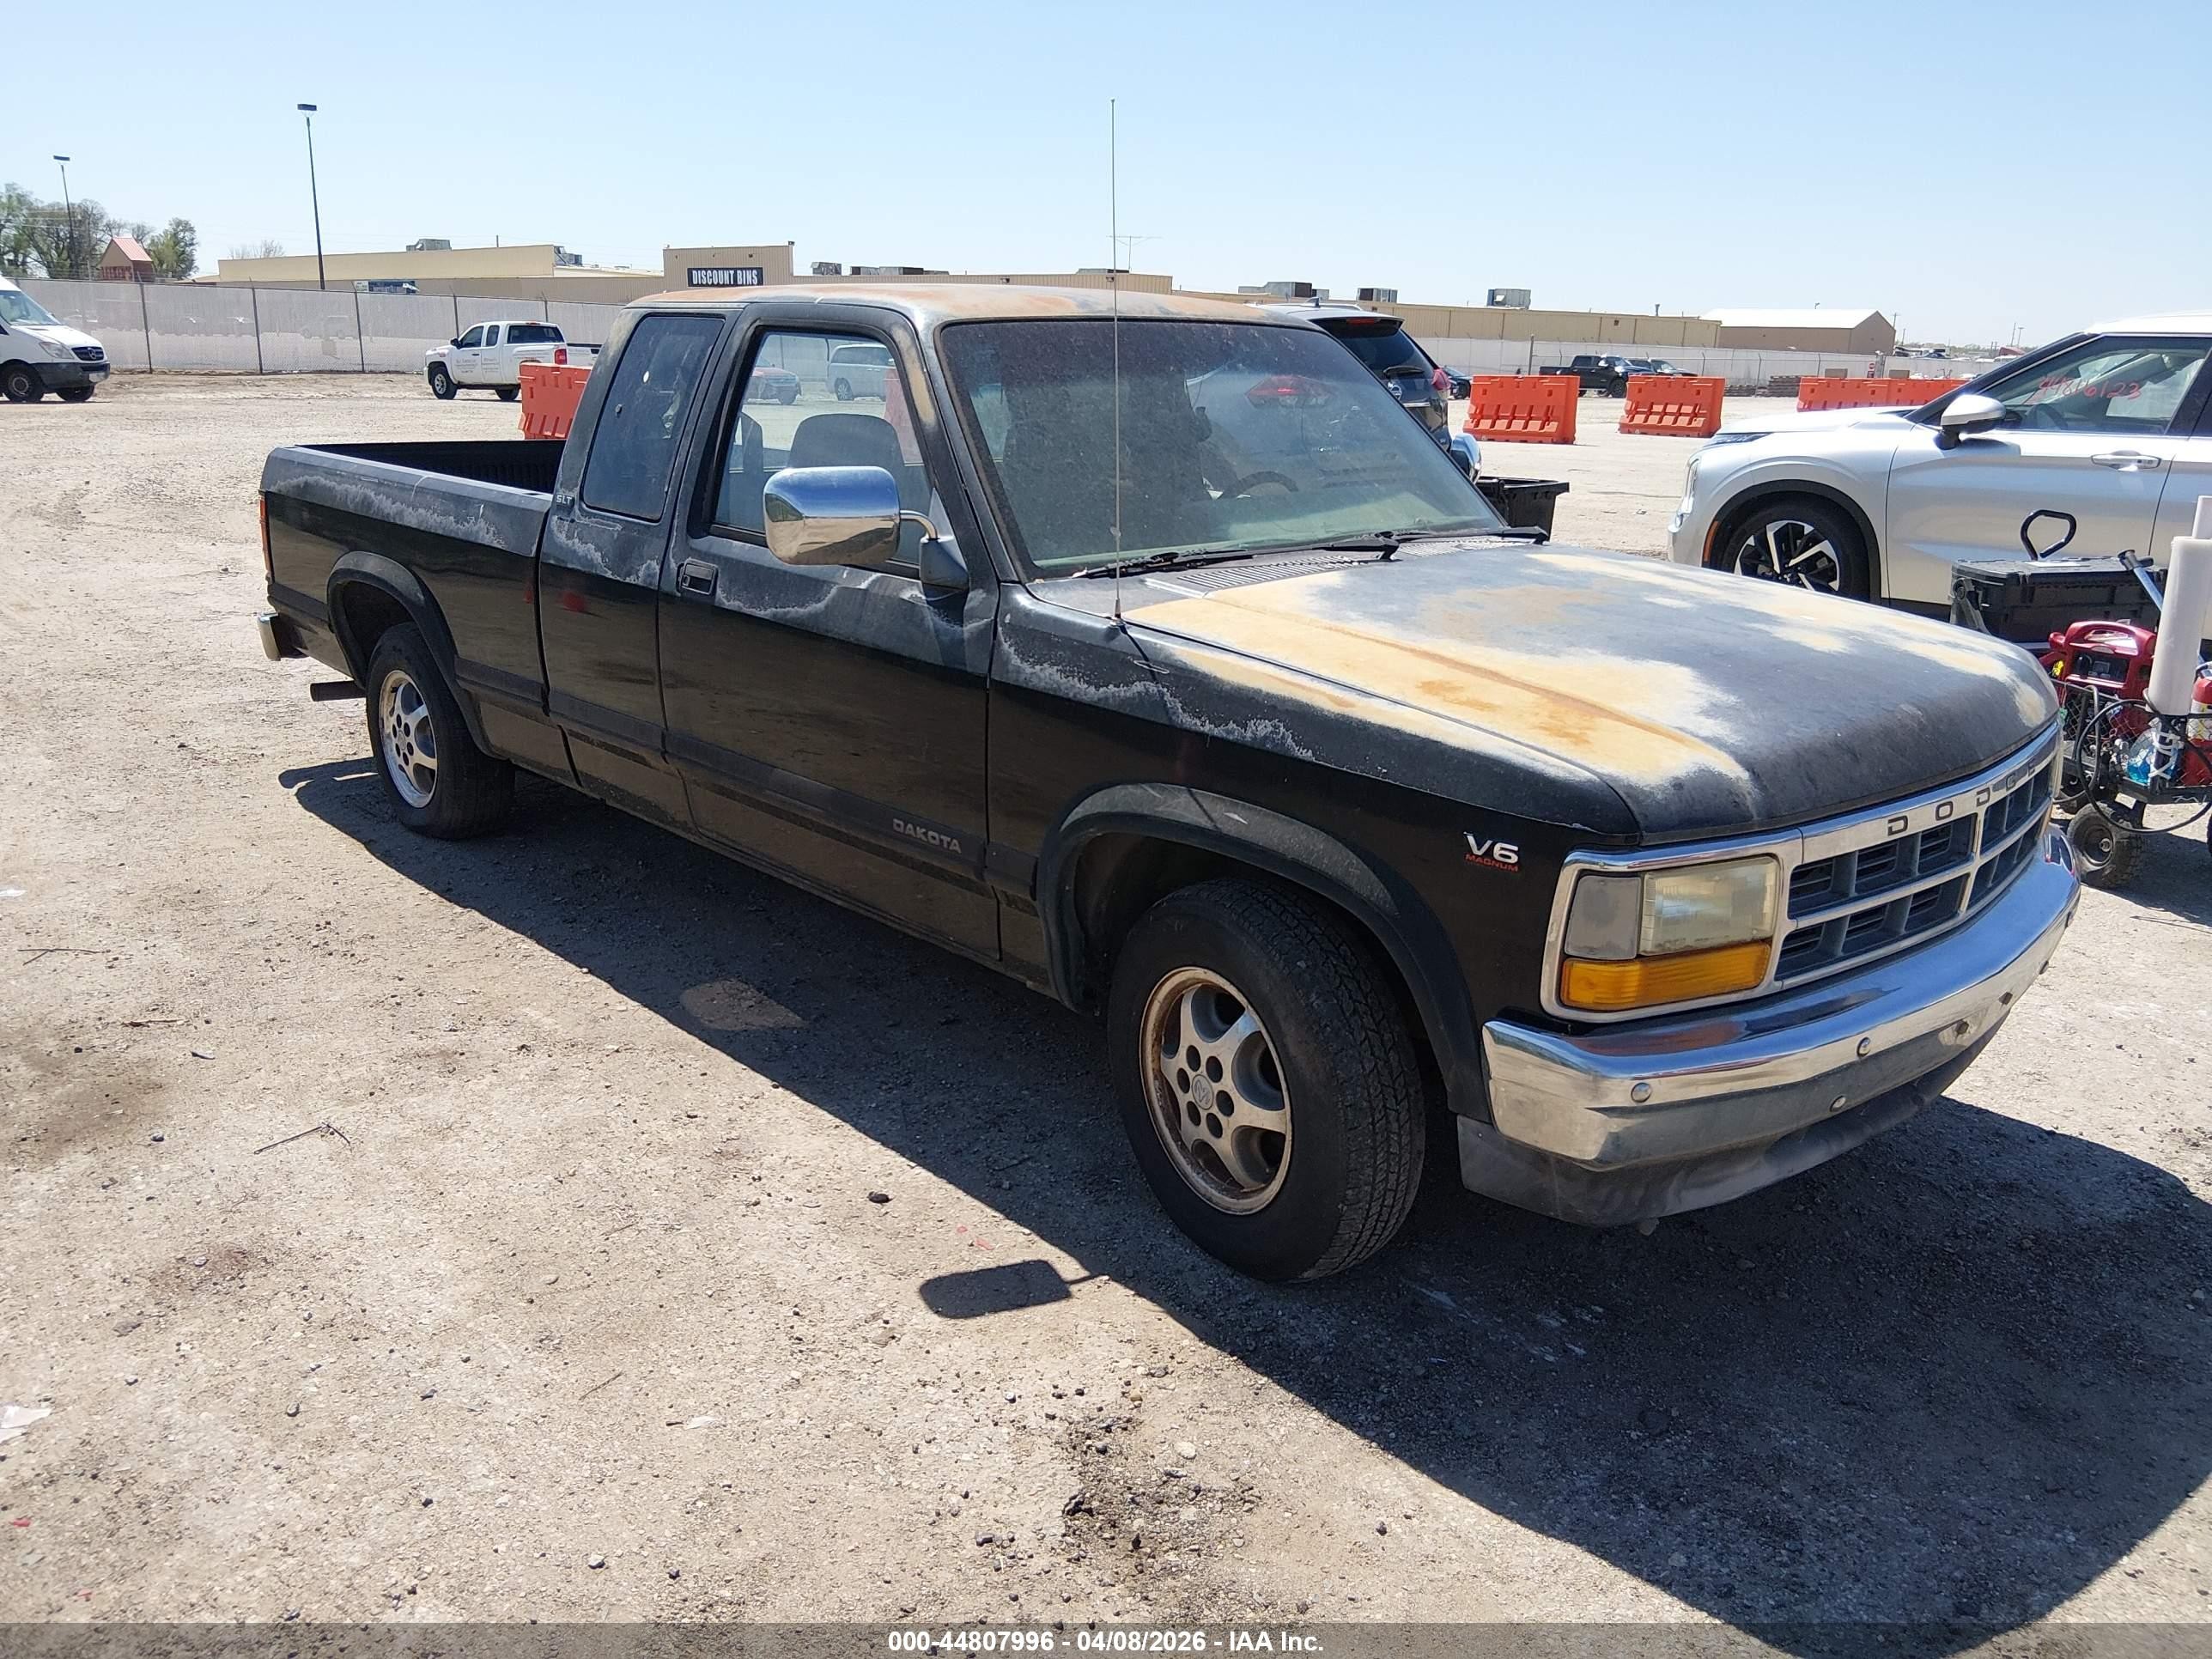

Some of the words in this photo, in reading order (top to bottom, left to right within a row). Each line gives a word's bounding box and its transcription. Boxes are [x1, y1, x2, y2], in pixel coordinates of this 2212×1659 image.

[692, 270, 734, 284] DISCOUNT
[737, 270, 757, 284] BINS
[556, 494, 573, 505] SLT
[1887, 761, 2037, 836] DODGE
[892, 818, 962, 854] DAKOTA
[1463, 831, 1518, 863] V6
[1465, 854, 1518, 872] MAGNUM
